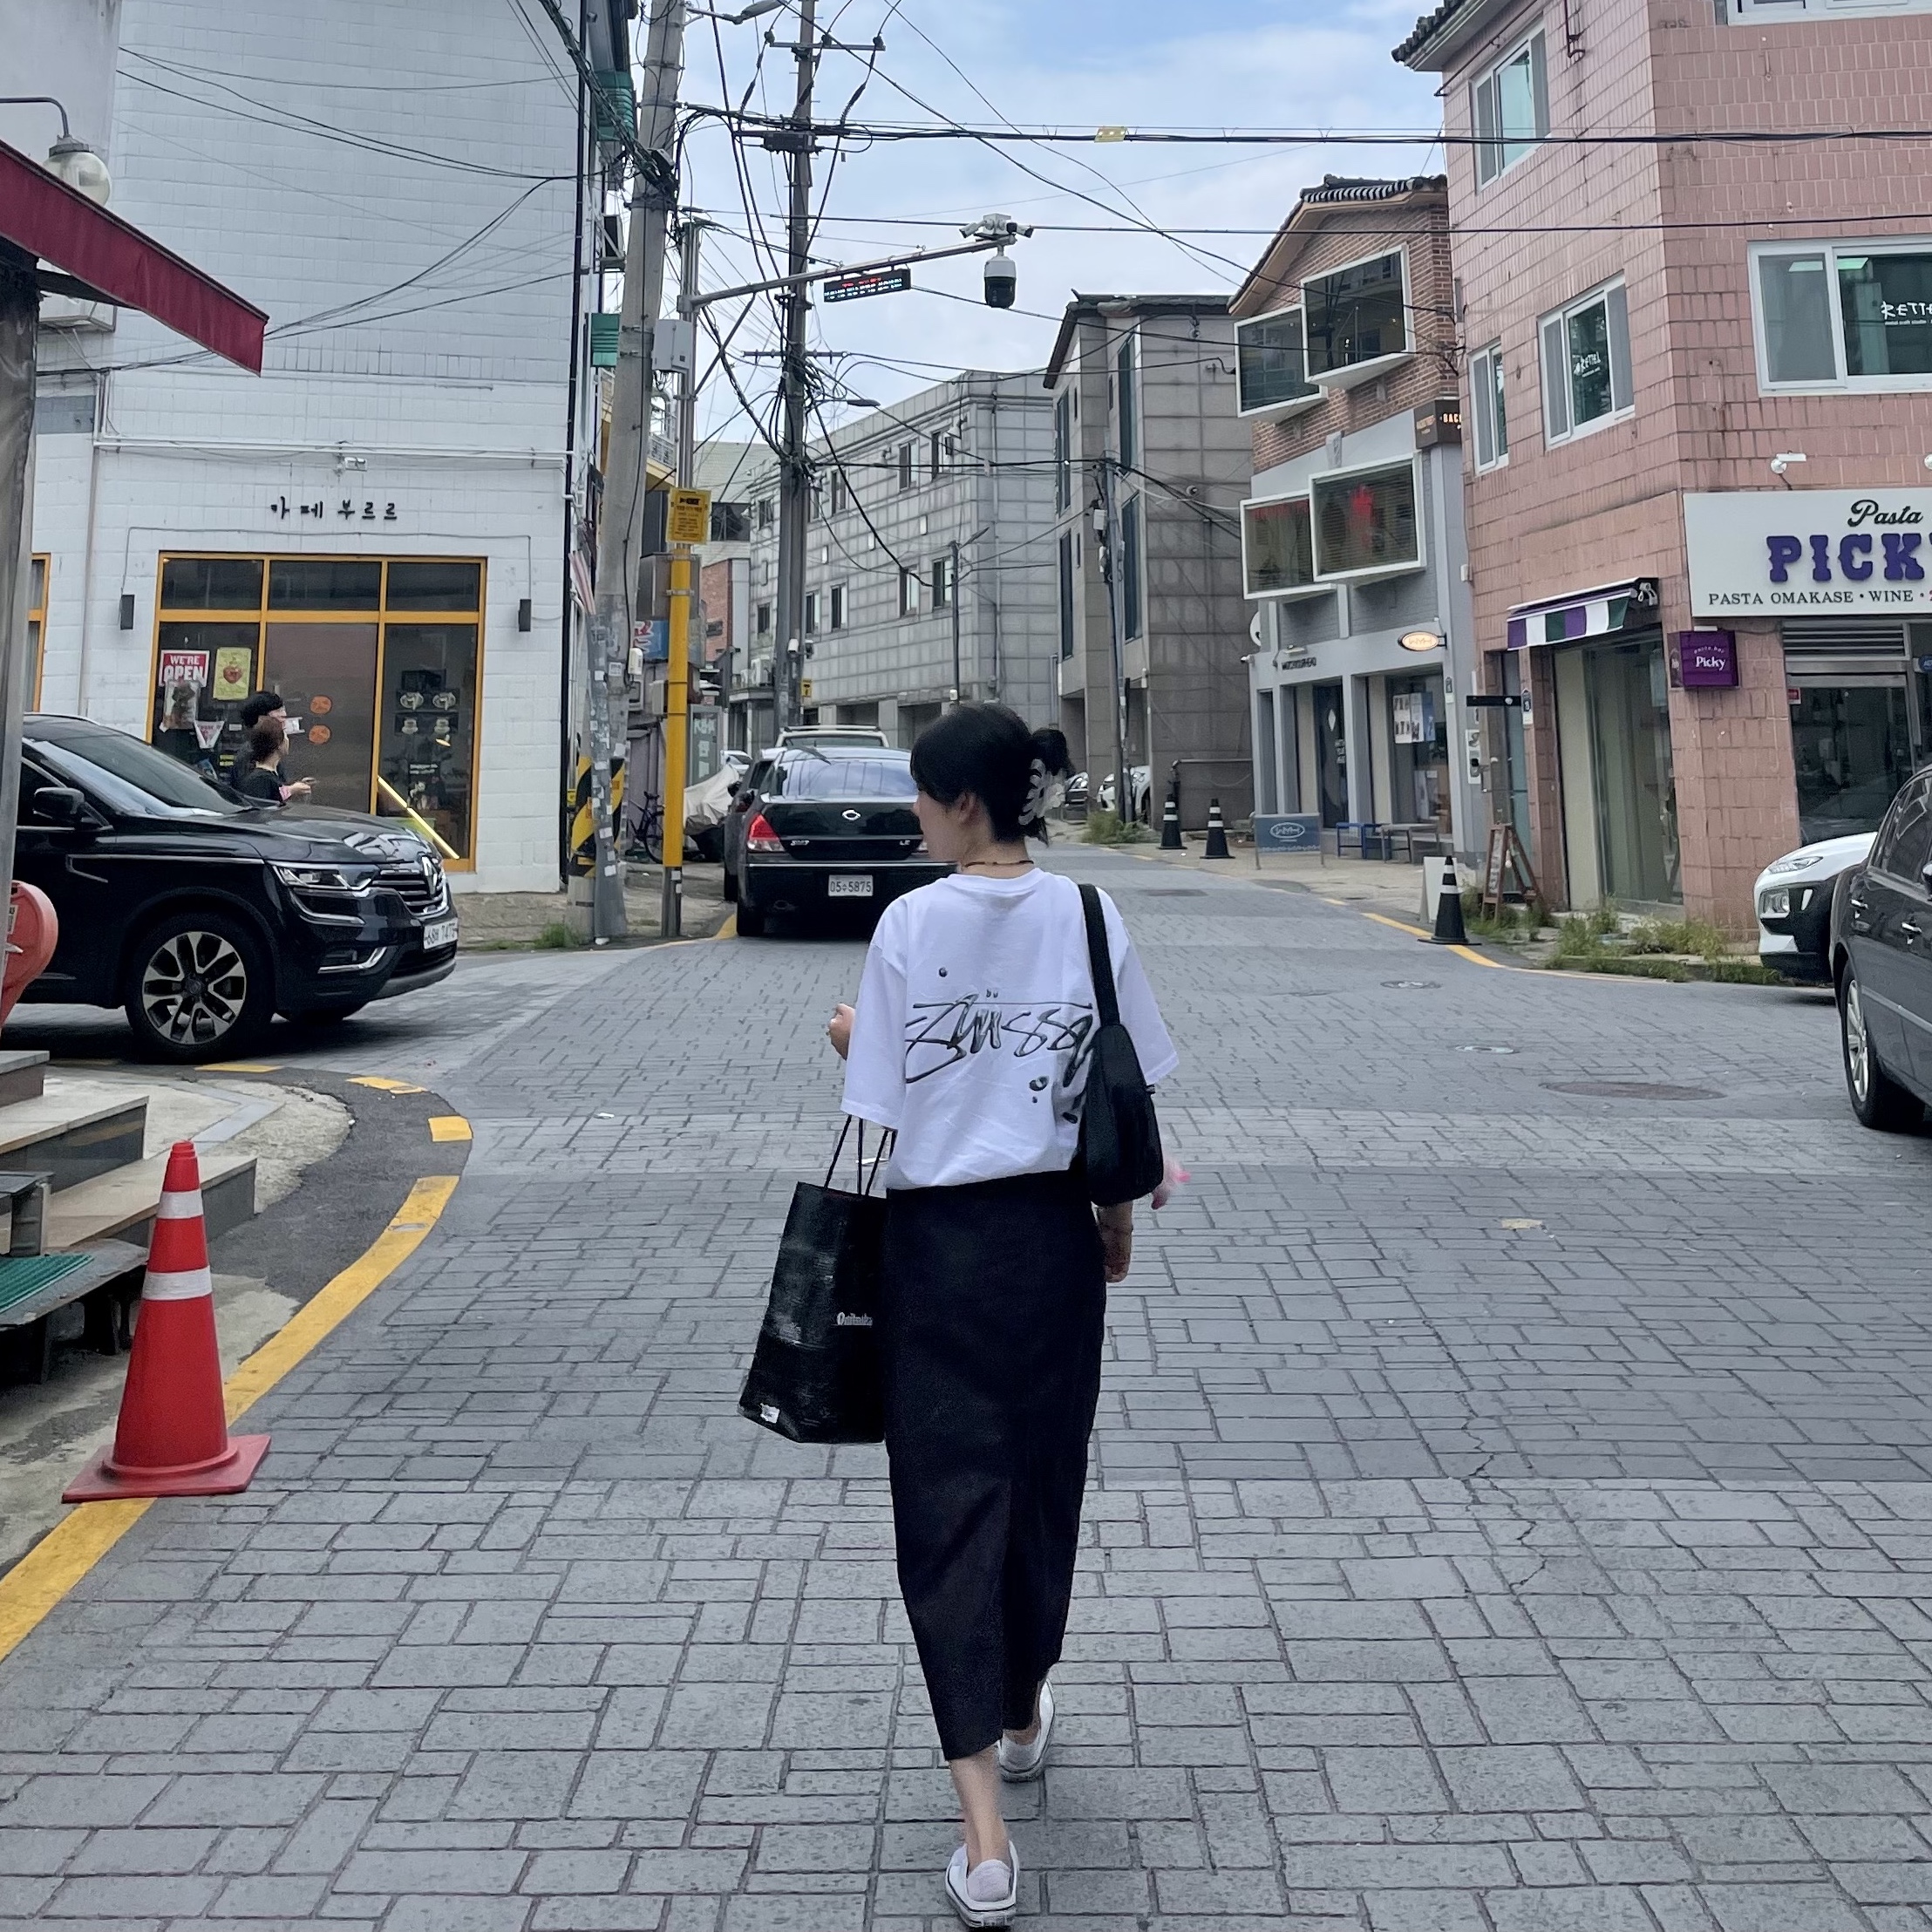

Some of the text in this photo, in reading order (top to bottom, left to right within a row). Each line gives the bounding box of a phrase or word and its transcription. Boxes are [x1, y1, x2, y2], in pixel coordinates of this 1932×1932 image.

[337, 499, 398, 520] 부르르
[1847, 499, 1924, 527] Pasta
[1766, 533, 1932, 582] PICK
[1709, 590, 1914, 605] PASTA OMAKASE WINE
[169, 655, 200, 666] WE'RE
[1696, 656, 1726, 671] Picky
[163, 665, 204, 682] OPEN
